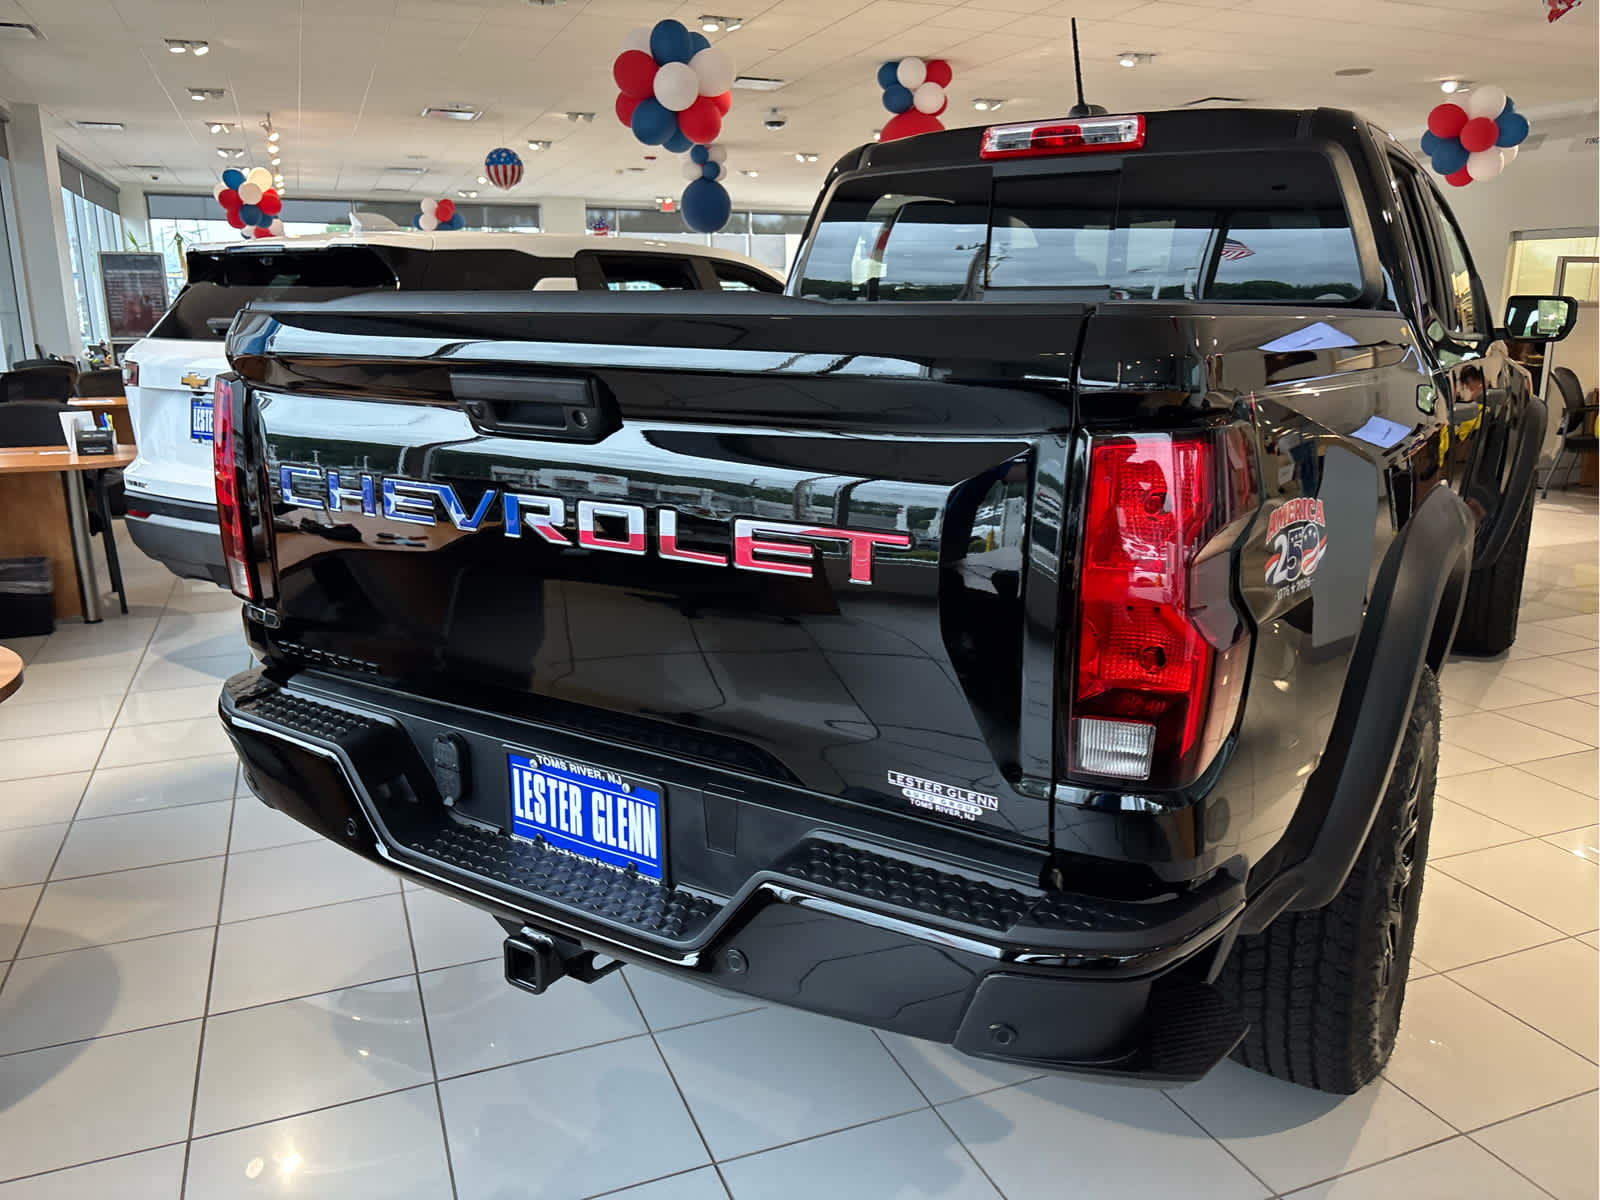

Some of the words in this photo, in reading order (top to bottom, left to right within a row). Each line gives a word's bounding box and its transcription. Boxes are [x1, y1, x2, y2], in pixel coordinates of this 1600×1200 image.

[193, 407, 214, 432] LESTE
[279, 463, 912, 585] CHEVROLET
[1265, 497, 1326, 546] AMERICA
[1273, 523, 1320, 584] 250
[536, 754, 568, 772] TOMS
[569, 763, 606, 782] RIVER,
[607, 772, 622, 785] NJ
[888, 772, 943, 794] LESTER
[947, 788, 998, 809] GLENN
[905, 790, 934, 801] AUTO
[940, 799, 979, 813] GROUP
[512, 768, 583, 837] LESTER
[592, 791, 657, 860] GLENN
[910, 798, 934, 810] TOMS
[935, 803, 963, 819] RIVER,
[964, 813, 976, 821] NJ
